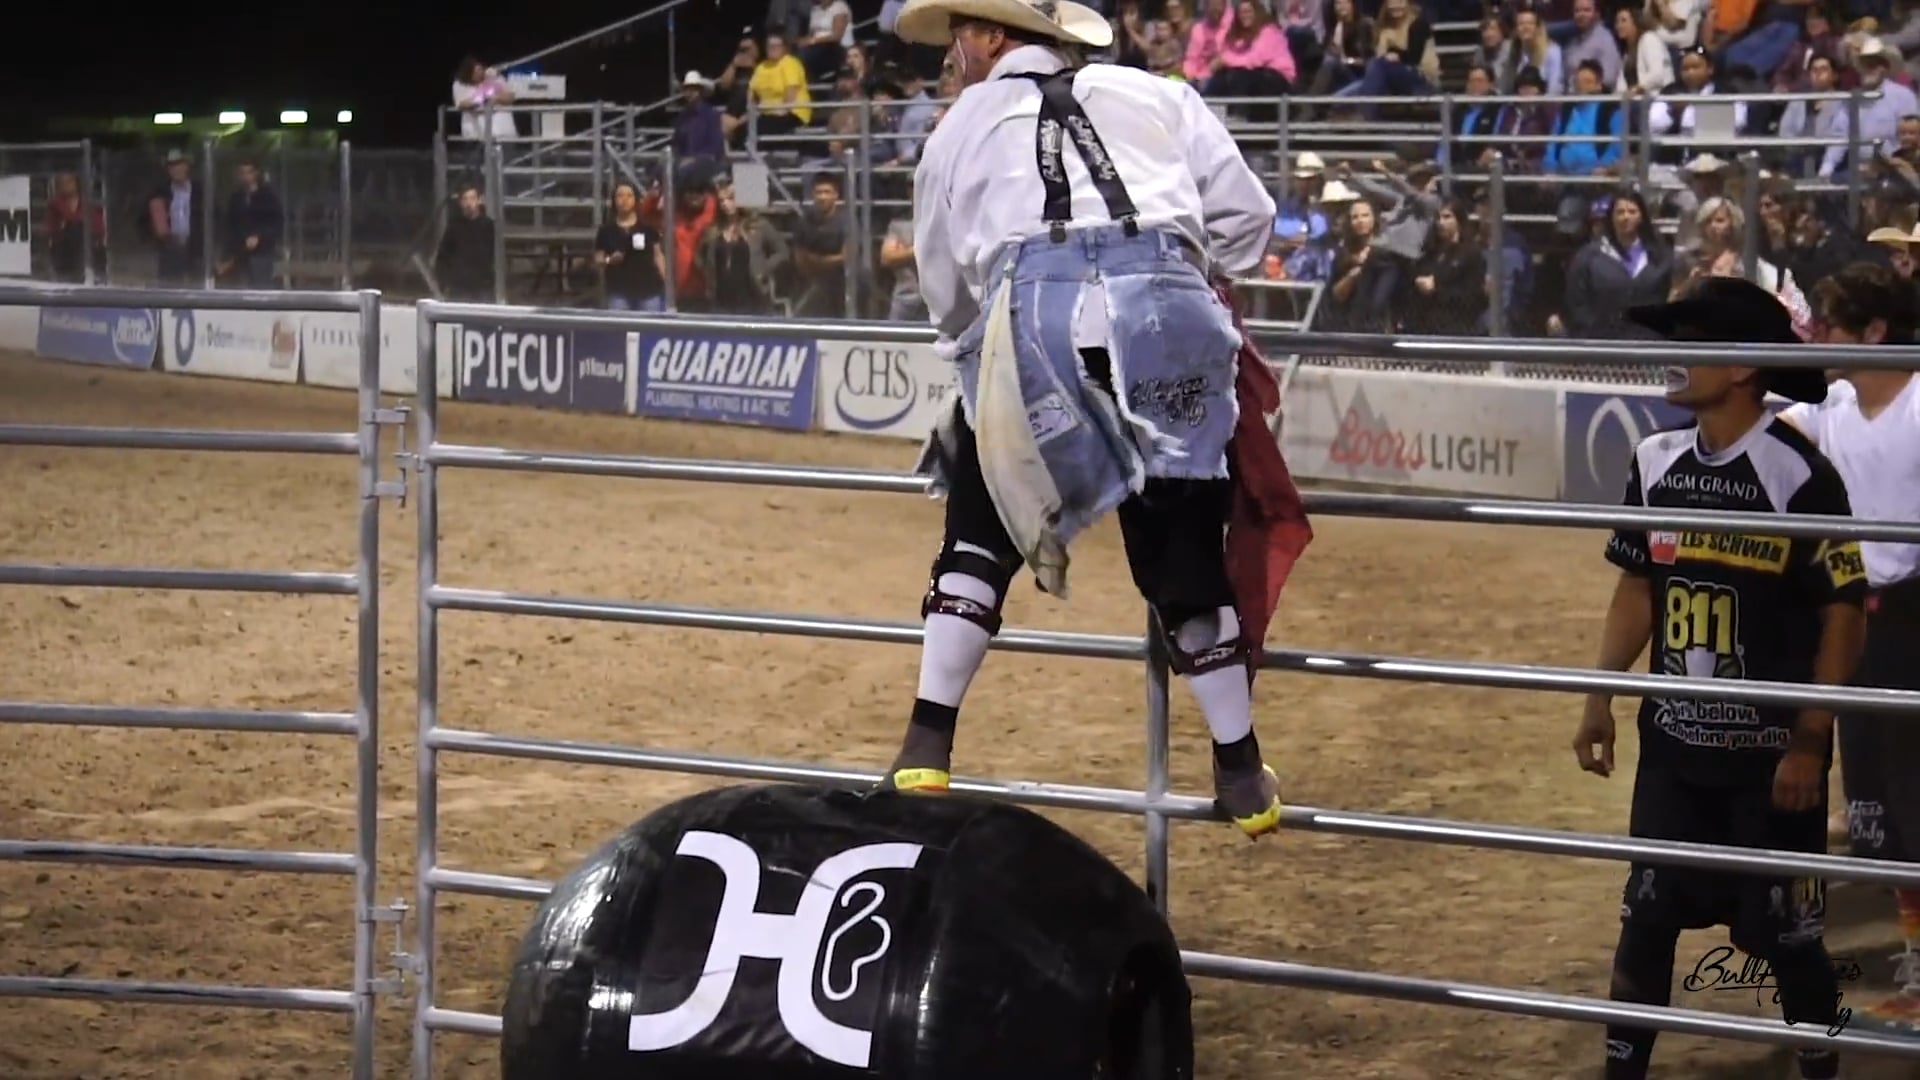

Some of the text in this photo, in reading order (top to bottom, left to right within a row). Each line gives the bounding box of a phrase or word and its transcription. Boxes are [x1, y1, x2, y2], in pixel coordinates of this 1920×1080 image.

[463, 330, 565, 394] P1FCU
[579, 357, 624, 383] p1fcu.org
[648, 337, 808, 388] GUARDIAN
[843, 346, 909, 400] CHS
[1329, 408, 1520, 477] Coors LIGHT
[1658, 473, 1696, 490] MGM
[1700, 475, 1758, 500] GRAND
[1666, 585, 1733, 655] 811
